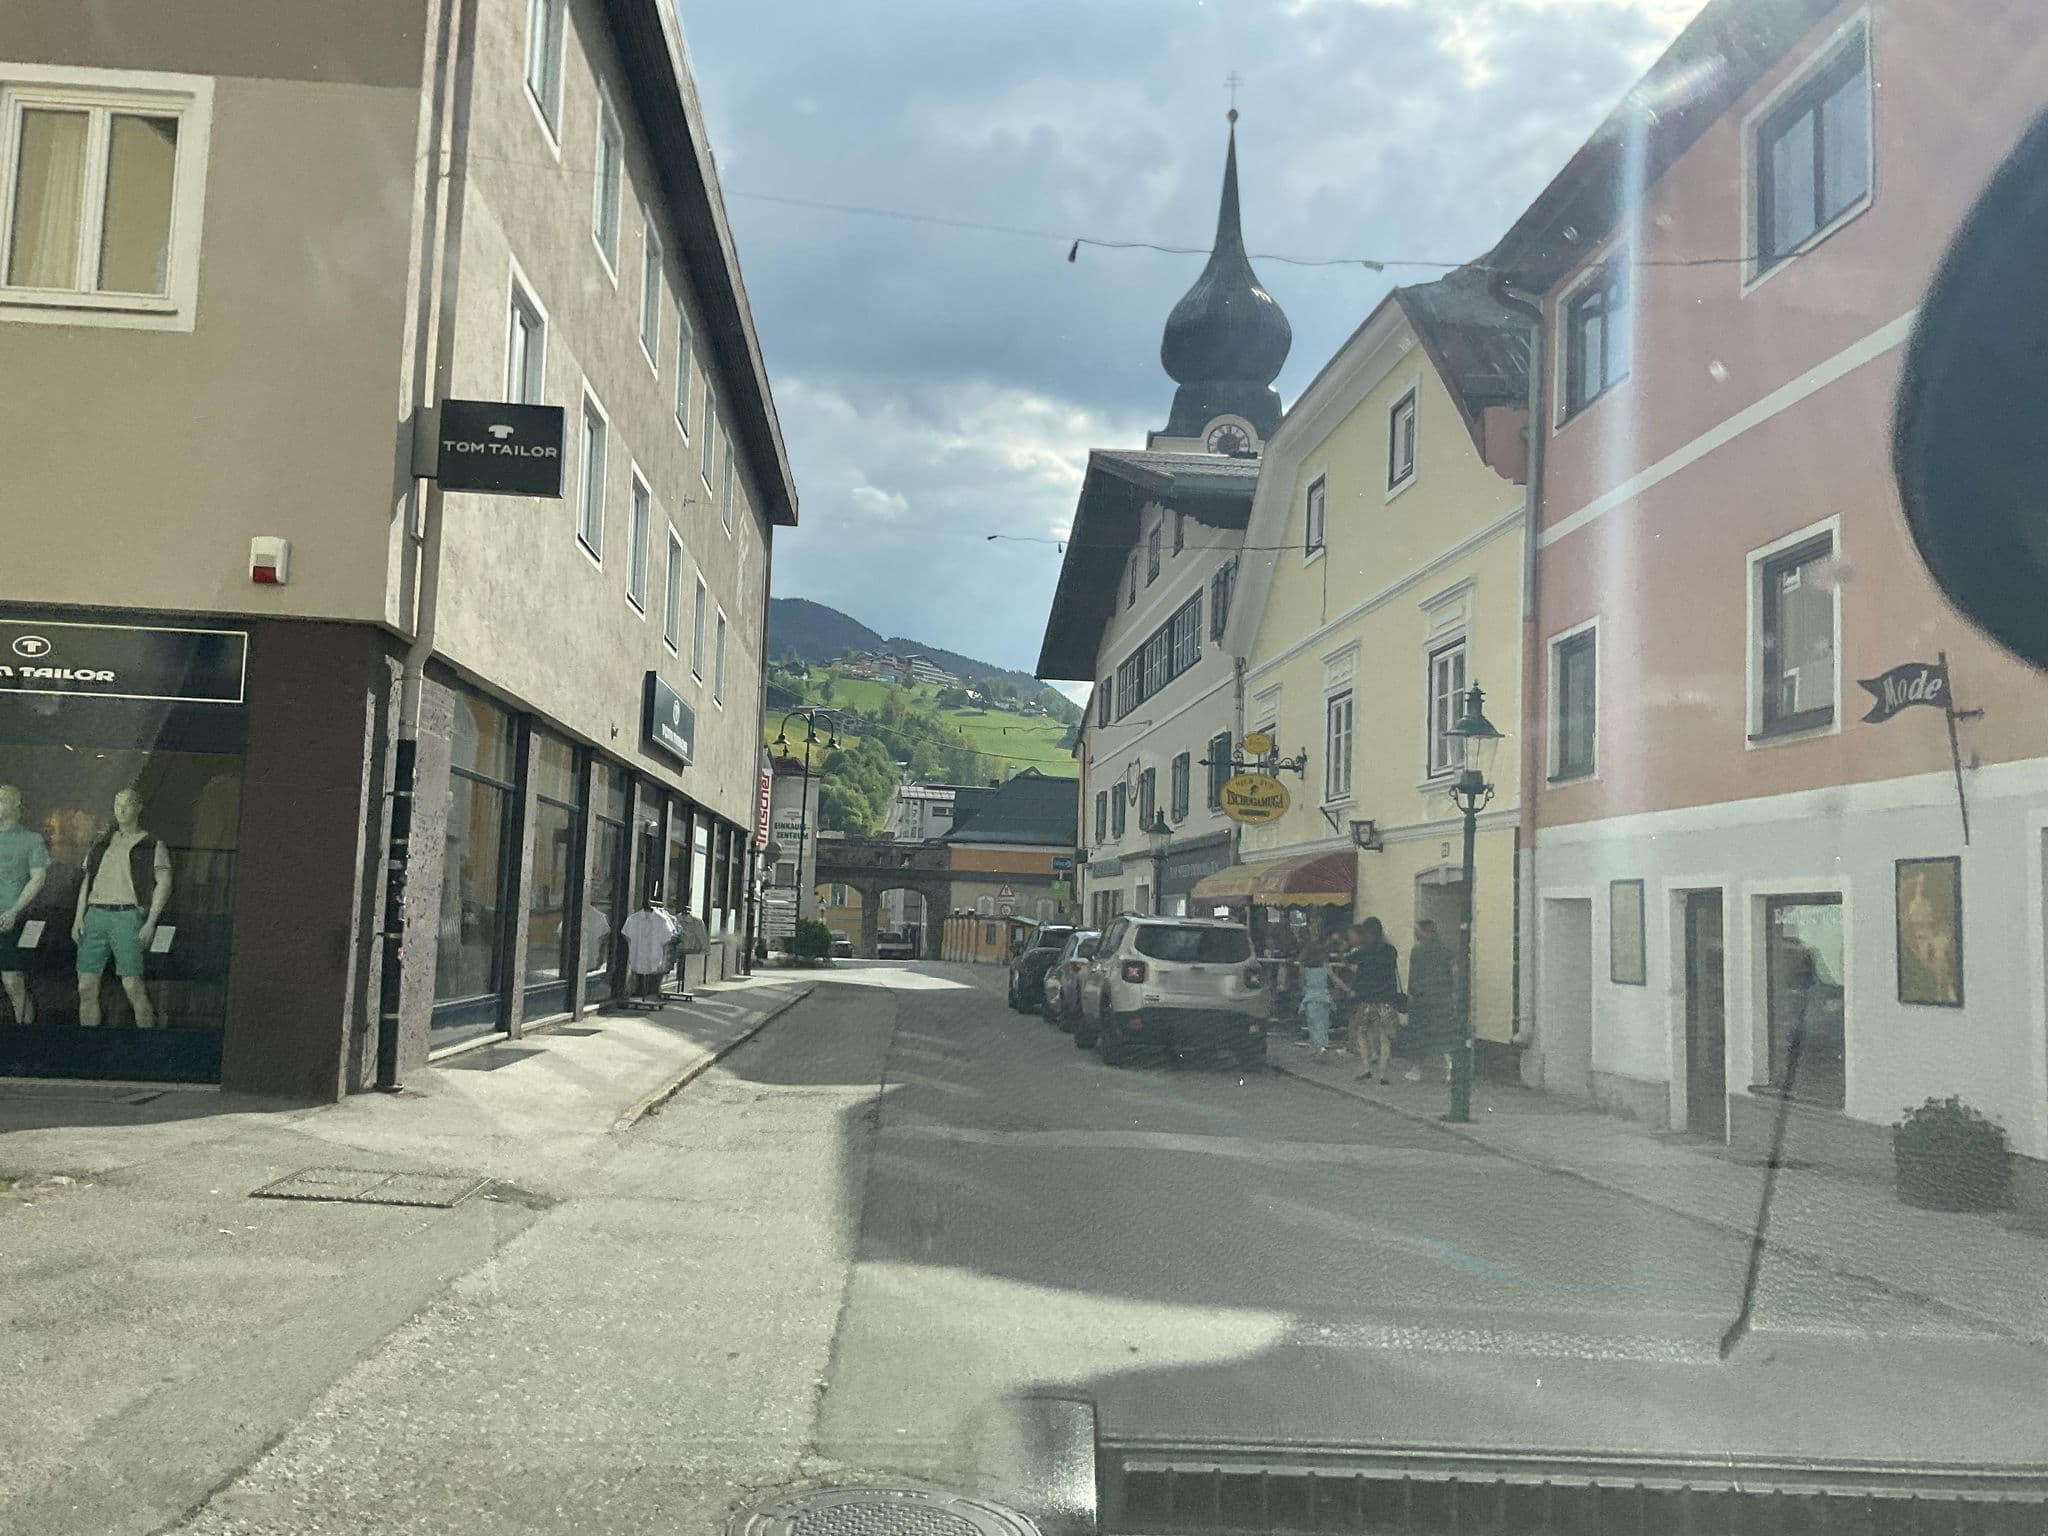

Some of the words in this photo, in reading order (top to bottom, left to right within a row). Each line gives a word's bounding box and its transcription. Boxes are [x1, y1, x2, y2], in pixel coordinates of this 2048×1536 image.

[443, 440, 485, 453] TOM
[488, 443, 558, 458] TAILOR
[19, 666, 115, 682] TAILOR
[1883, 670, 1943, 713] Mode
[776, 831, 809, 840] ZENTRUM
